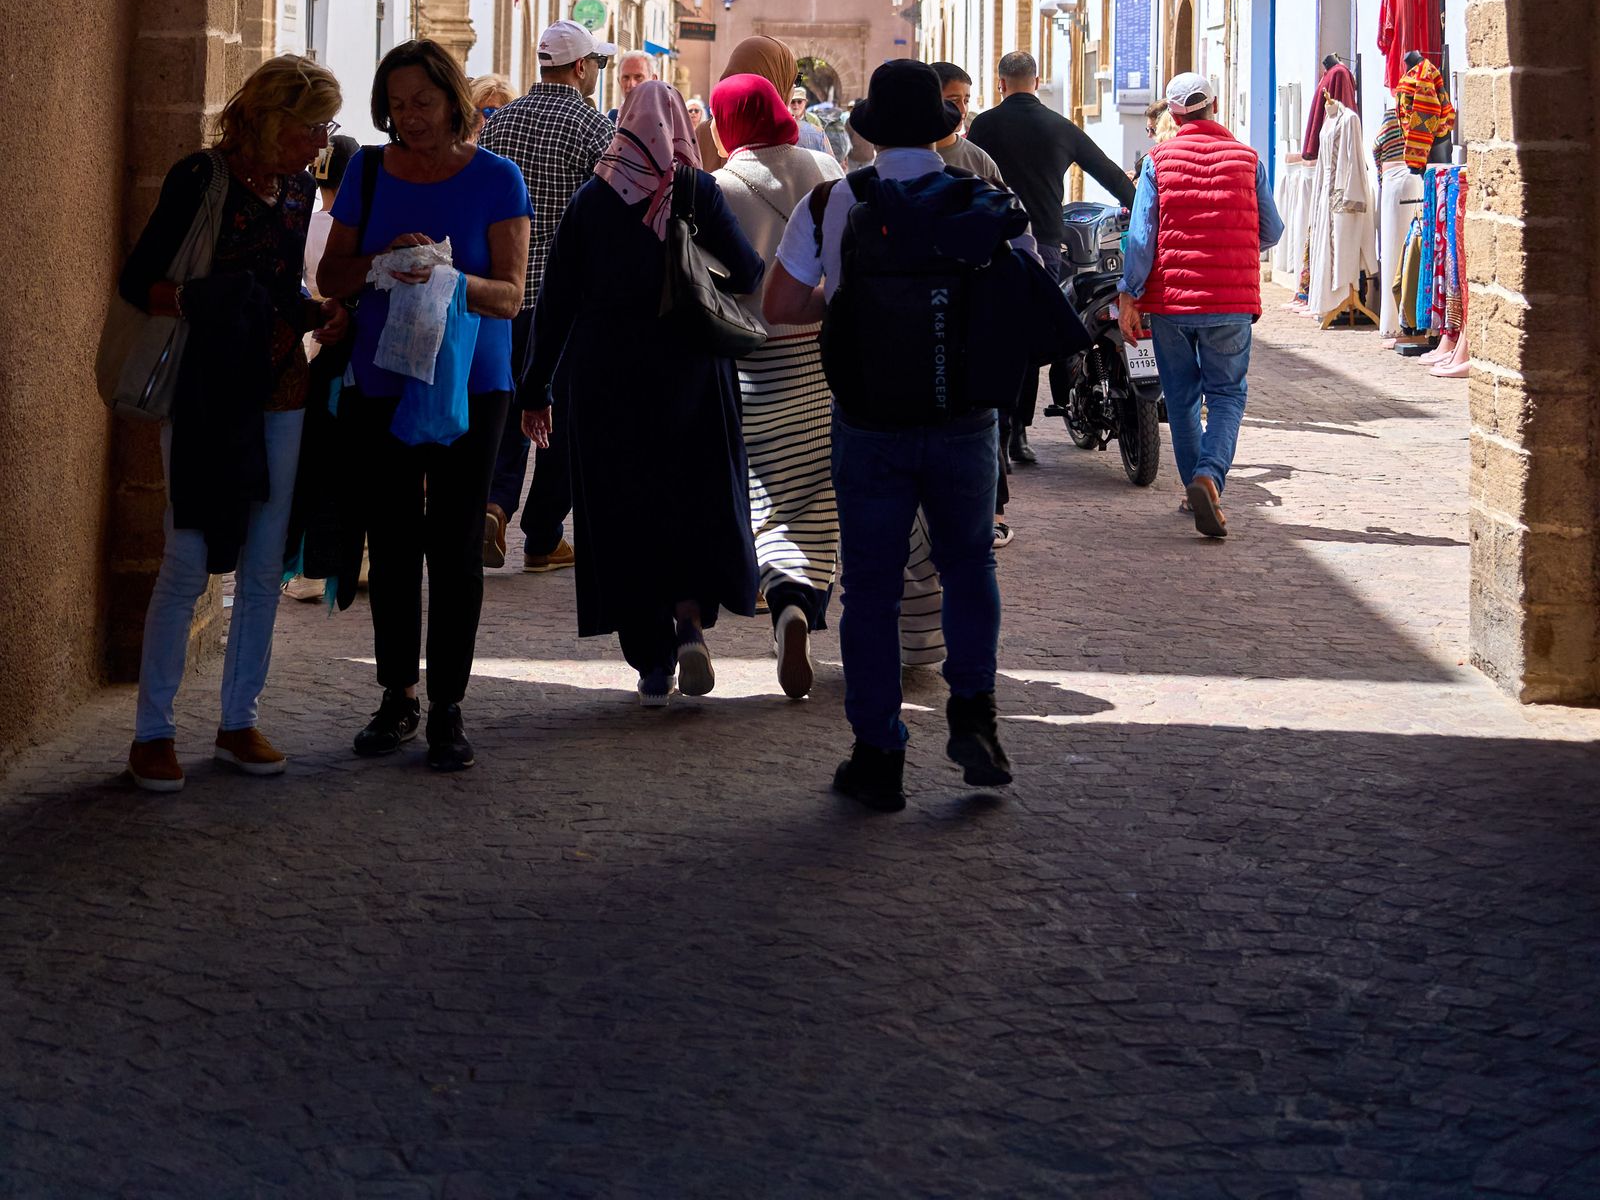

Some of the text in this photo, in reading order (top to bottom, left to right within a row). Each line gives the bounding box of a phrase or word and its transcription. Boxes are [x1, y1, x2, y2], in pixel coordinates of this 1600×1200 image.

[935, 312, 946, 409] K&F CONCEPT
[1130, 360, 1156, 368] 01195
